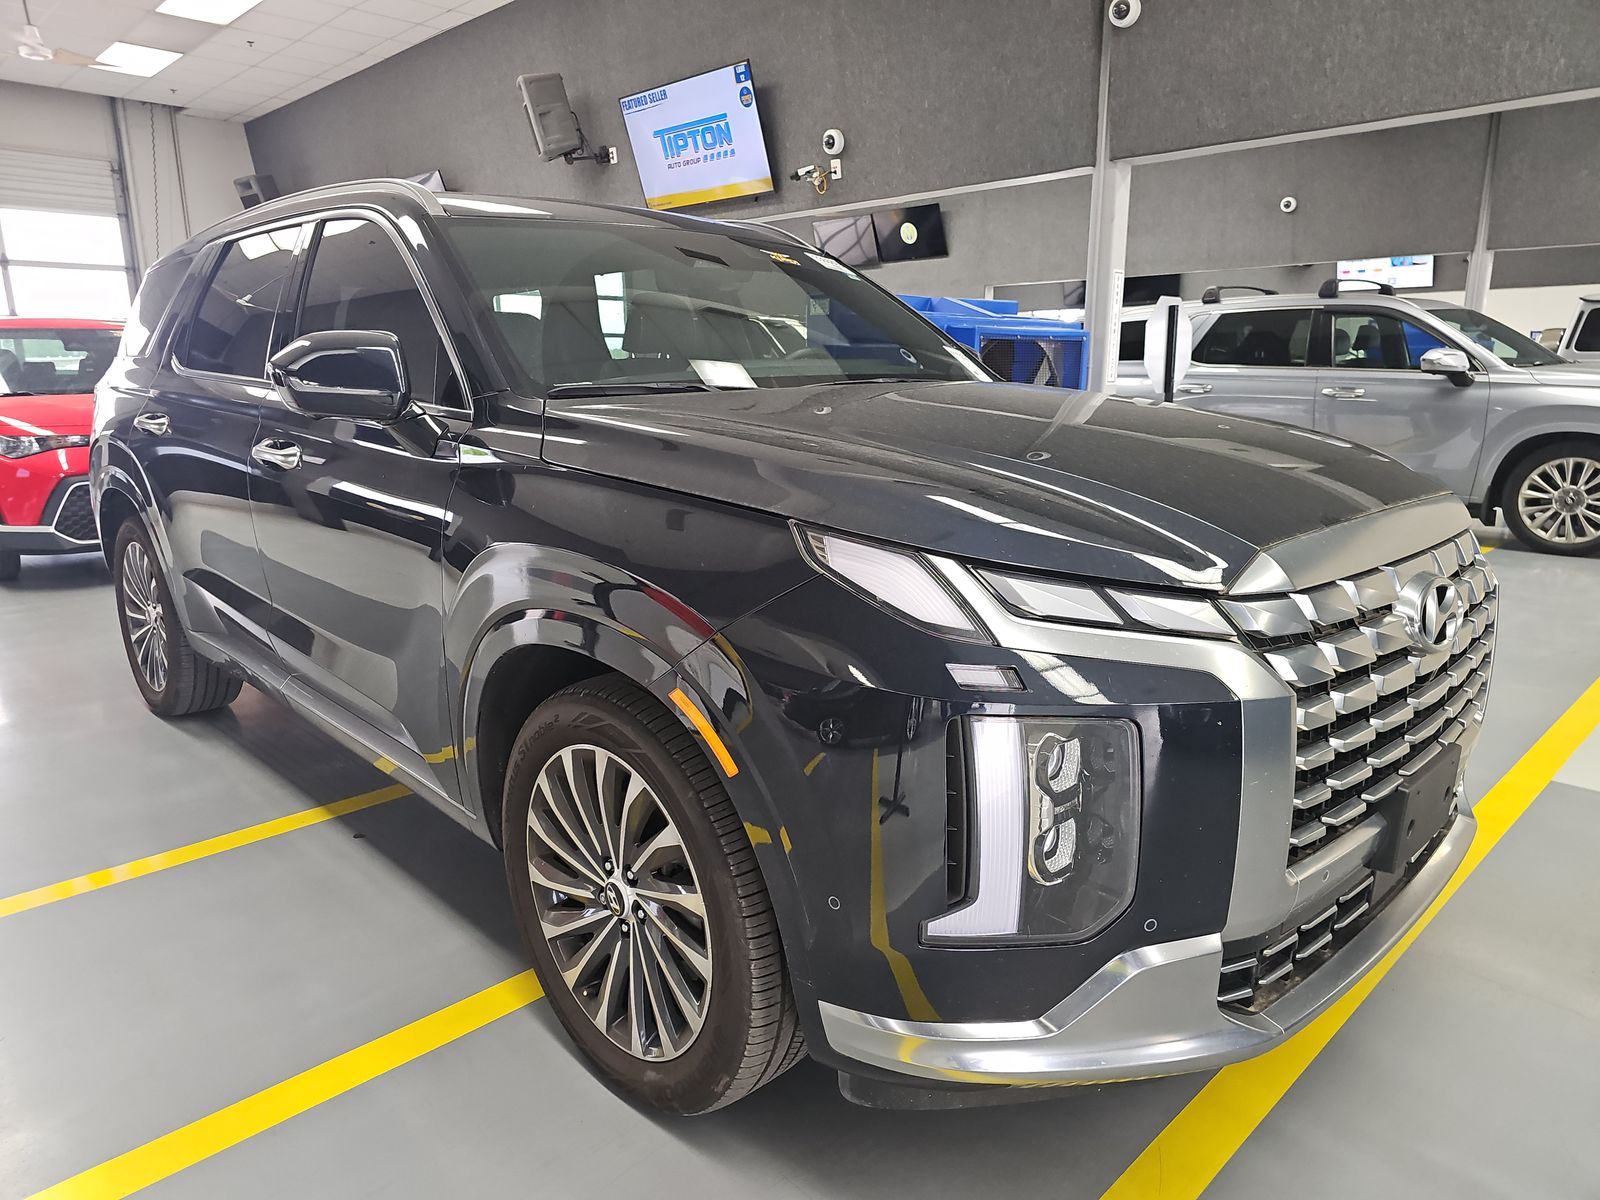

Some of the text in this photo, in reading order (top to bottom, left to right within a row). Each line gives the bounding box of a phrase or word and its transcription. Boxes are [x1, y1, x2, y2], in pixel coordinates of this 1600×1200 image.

[621, 89, 668, 112] FEATURED SELLER
[653, 113, 733, 160] TIPTON
[667, 157, 702, 170] AUTO GROUP
